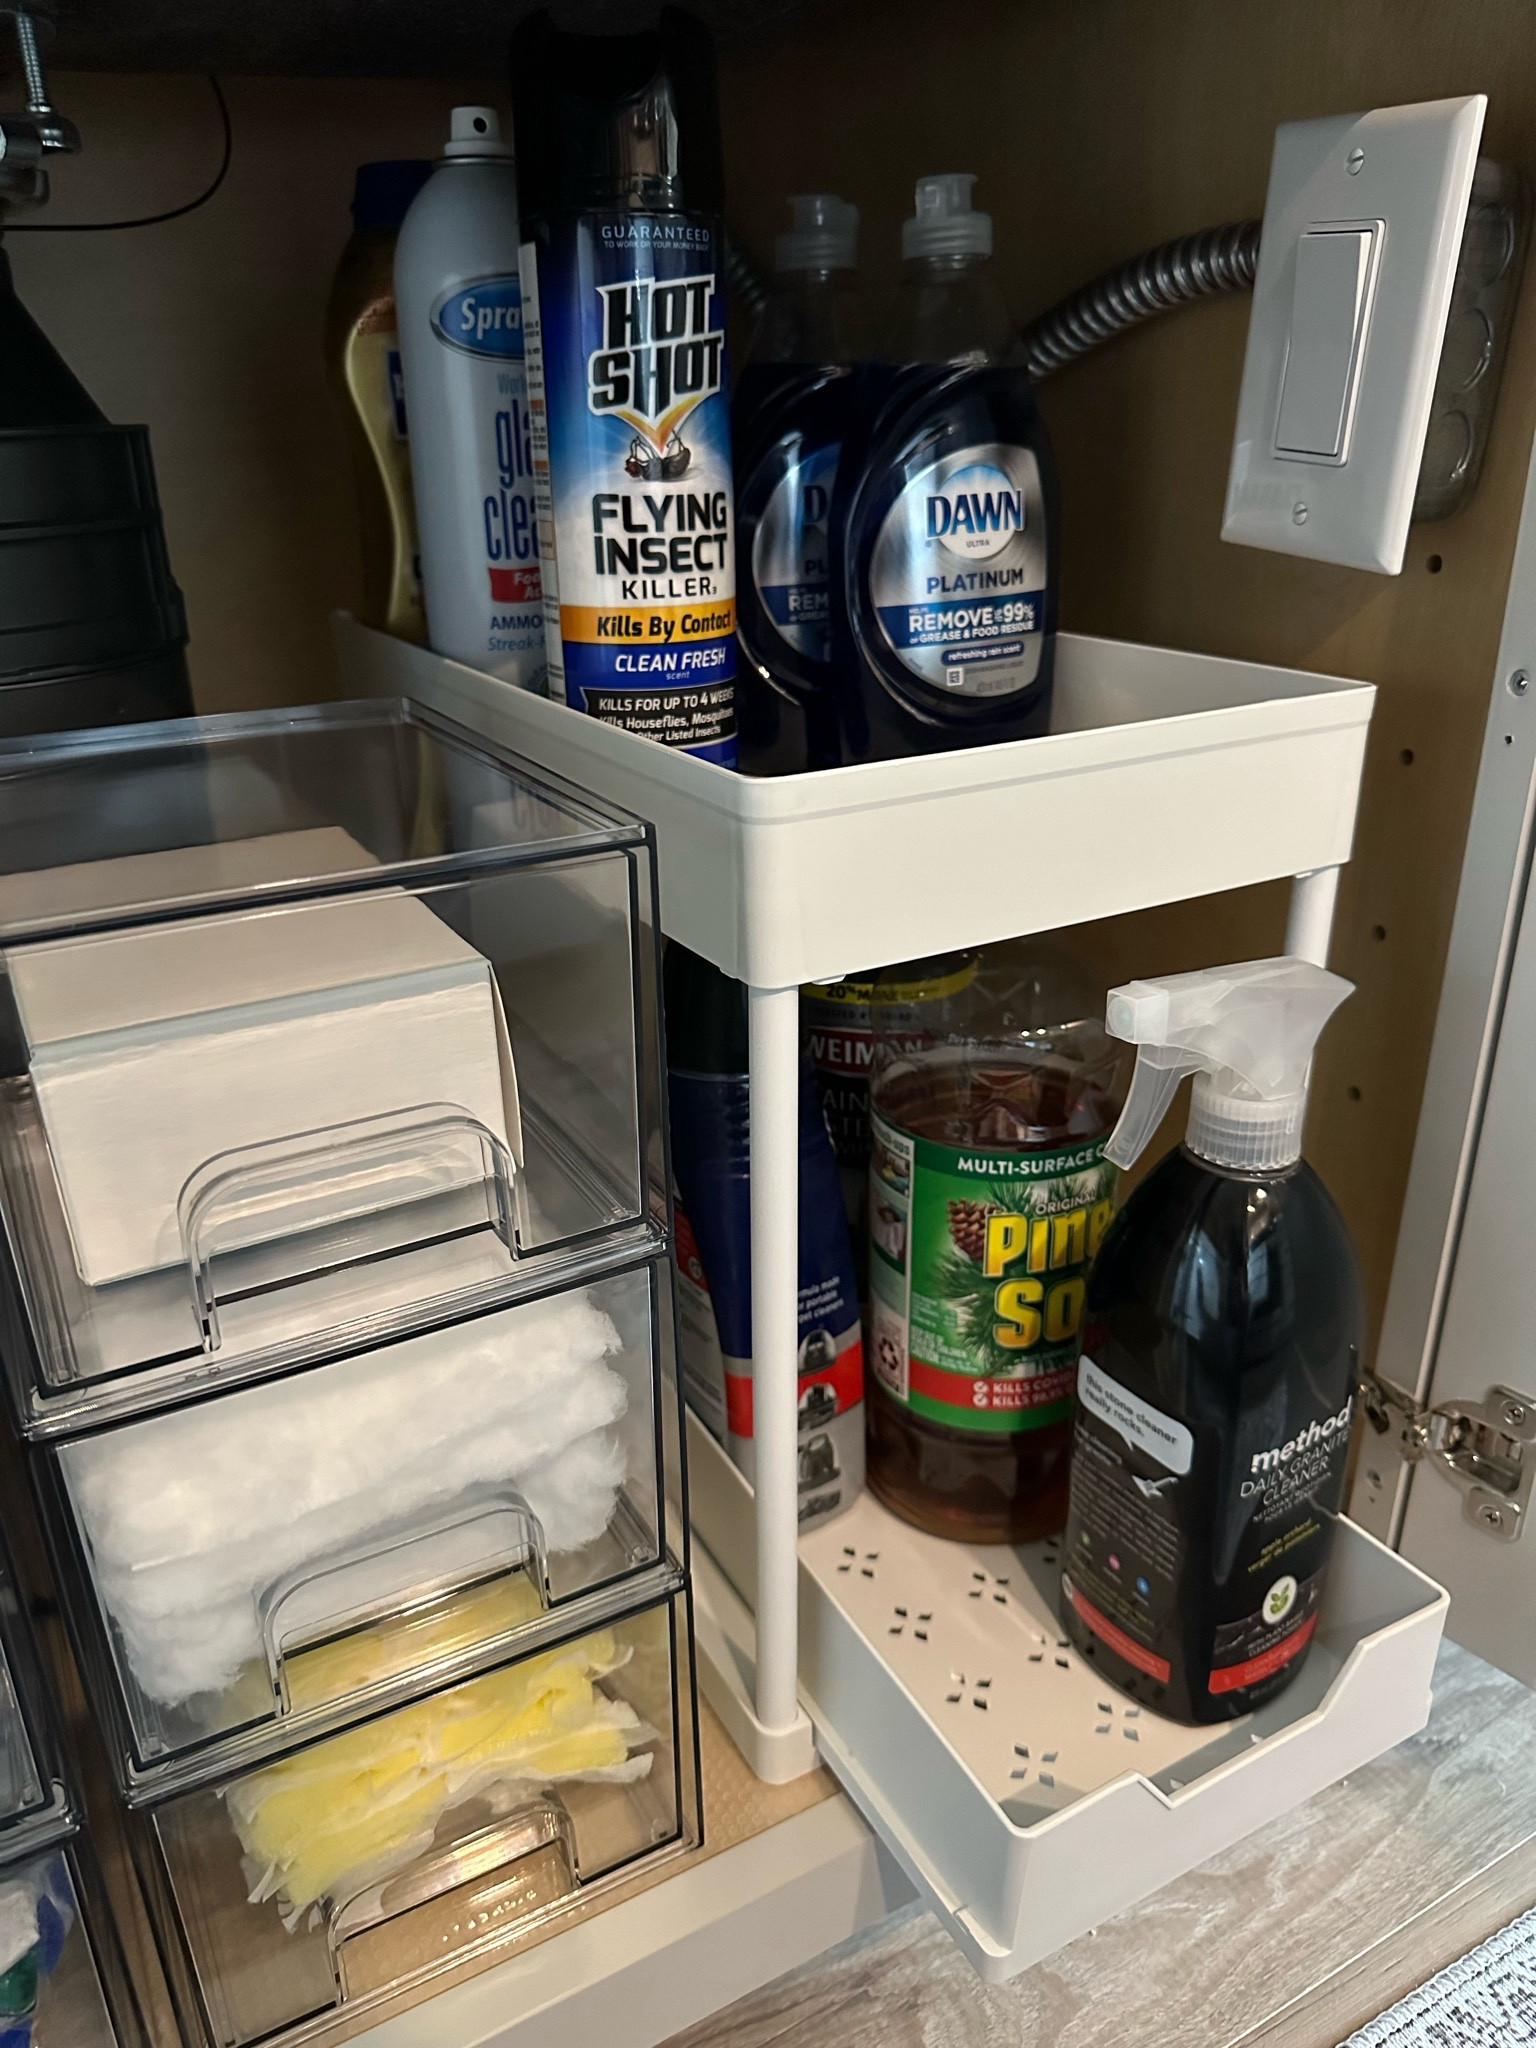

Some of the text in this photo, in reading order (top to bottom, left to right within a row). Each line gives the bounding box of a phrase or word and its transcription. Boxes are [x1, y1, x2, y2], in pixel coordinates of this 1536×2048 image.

[602, 226, 709, 242] GUARANTEED
[461, 297, 521, 340] Spra
[597, 275, 715, 350] HOT
[589, 330, 724, 424] SHOT
[496, 399, 533, 489] gla
[484, 489, 542, 561] clea
[592, 492, 728, 533] FLYING
[925, 489, 1025, 539] DAWN
[594, 533, 728, 575] INSECT
[966, 540, 990, 548] ULTRA
[927, 568, 1023, 594] PLATINUM
[788, 594, 829, 613] REM
[909, 607, 994, 633] REMOVE
[1003, 602, 1035, 623] 99%
[490, 615, 544, 630] AMMO
[597, 610, 731, 643] Kills By Contact
[919, 631, 962, 643] GREASE
[963, 631, 971, 639] &
[972, 626, 999, 638] FOOD
[1001, 621, 1034, 635] RESIDUE
[488, 636, 546, 651] Streak-
[615, 647, 726, 672] CLEAN FRESH
[665, 671, 690, 681] scent
[598, 686, 735, 711] KILLS FOR UP TO 4 WEEKS
[625, 715, 689, 729] Houseflies,
[665, 728, 694, 741] Listed
[695, 725, 721, 737] Insects
[957, 1148, 1094, 1176] MULTI-SURFACE
[1035, 1190, 1096, 1215] ORIGINAL
[993, 1276, 1086, 1349] So
[992, 1382, 1031, 1395] KILLS
[992, 1394, 1031, 1408] KILLS
[1085, 1387, 1111, 1413] really
[1114, 1409, 1144, 1437] rocks.
[1086, 1373, 1103, 1394] this
[1105, 1390, 1133, 1415] stone
[1136, 1412, 1178, 1444] cleaner
[1250, 1394, 1352, 1474] method
[1240, 1430, 1349, 1498] DAILY GRANITE
[1263, 1455, 1329, 1506] CLEANER
